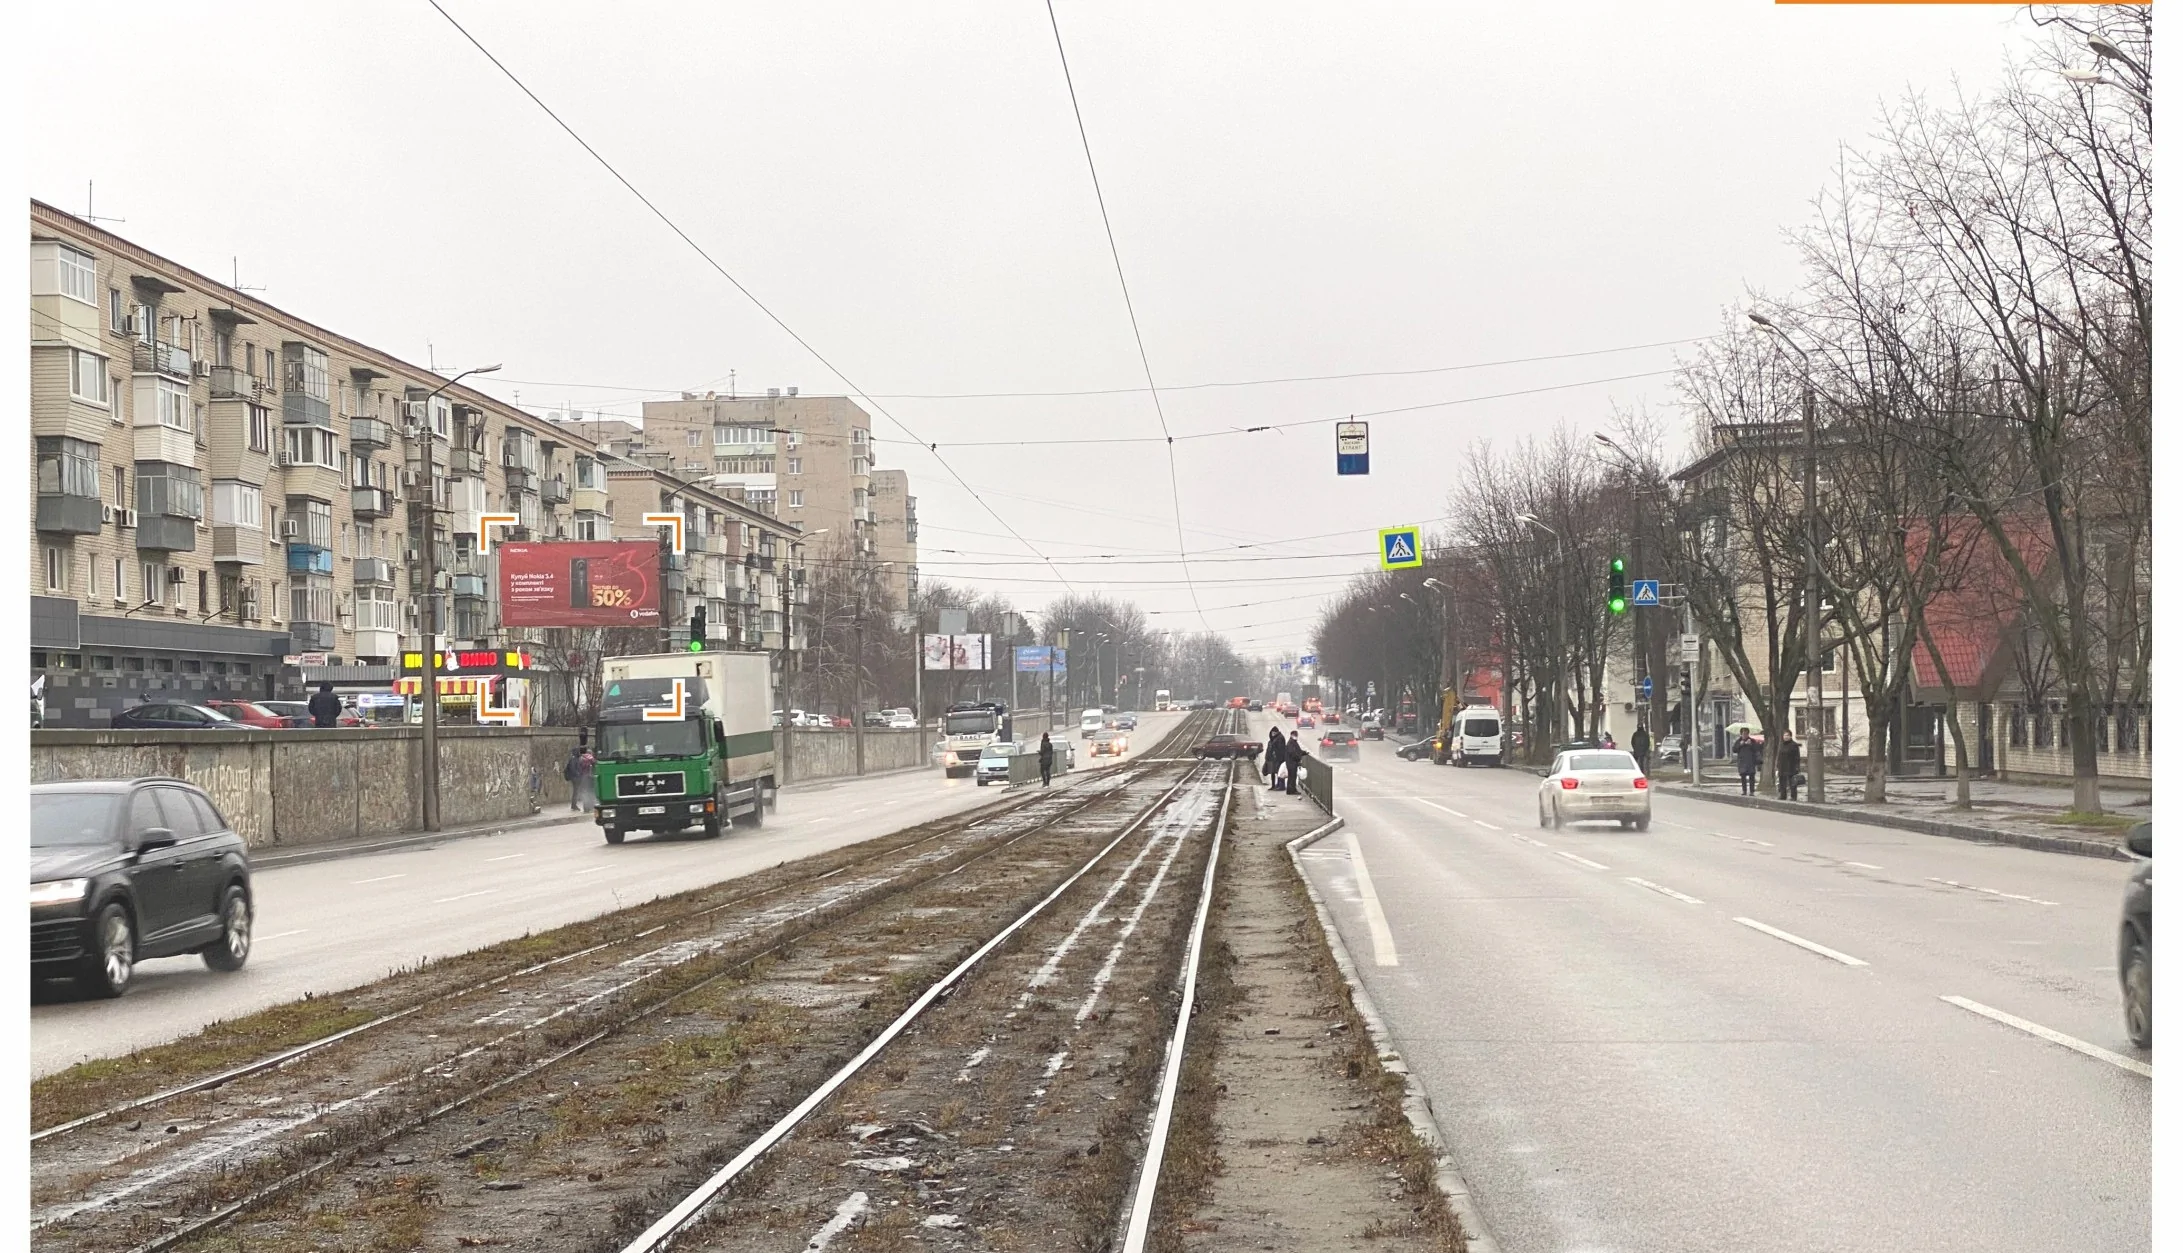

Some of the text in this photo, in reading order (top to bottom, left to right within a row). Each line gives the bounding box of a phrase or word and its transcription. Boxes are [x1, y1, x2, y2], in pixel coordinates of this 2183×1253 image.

[510, 573, 528, 581] Купуй
[592, 588, 633, 607] 50%
[404, 653, 442, 668] ПИО
[460, 651, 497, 667] ВИНО
